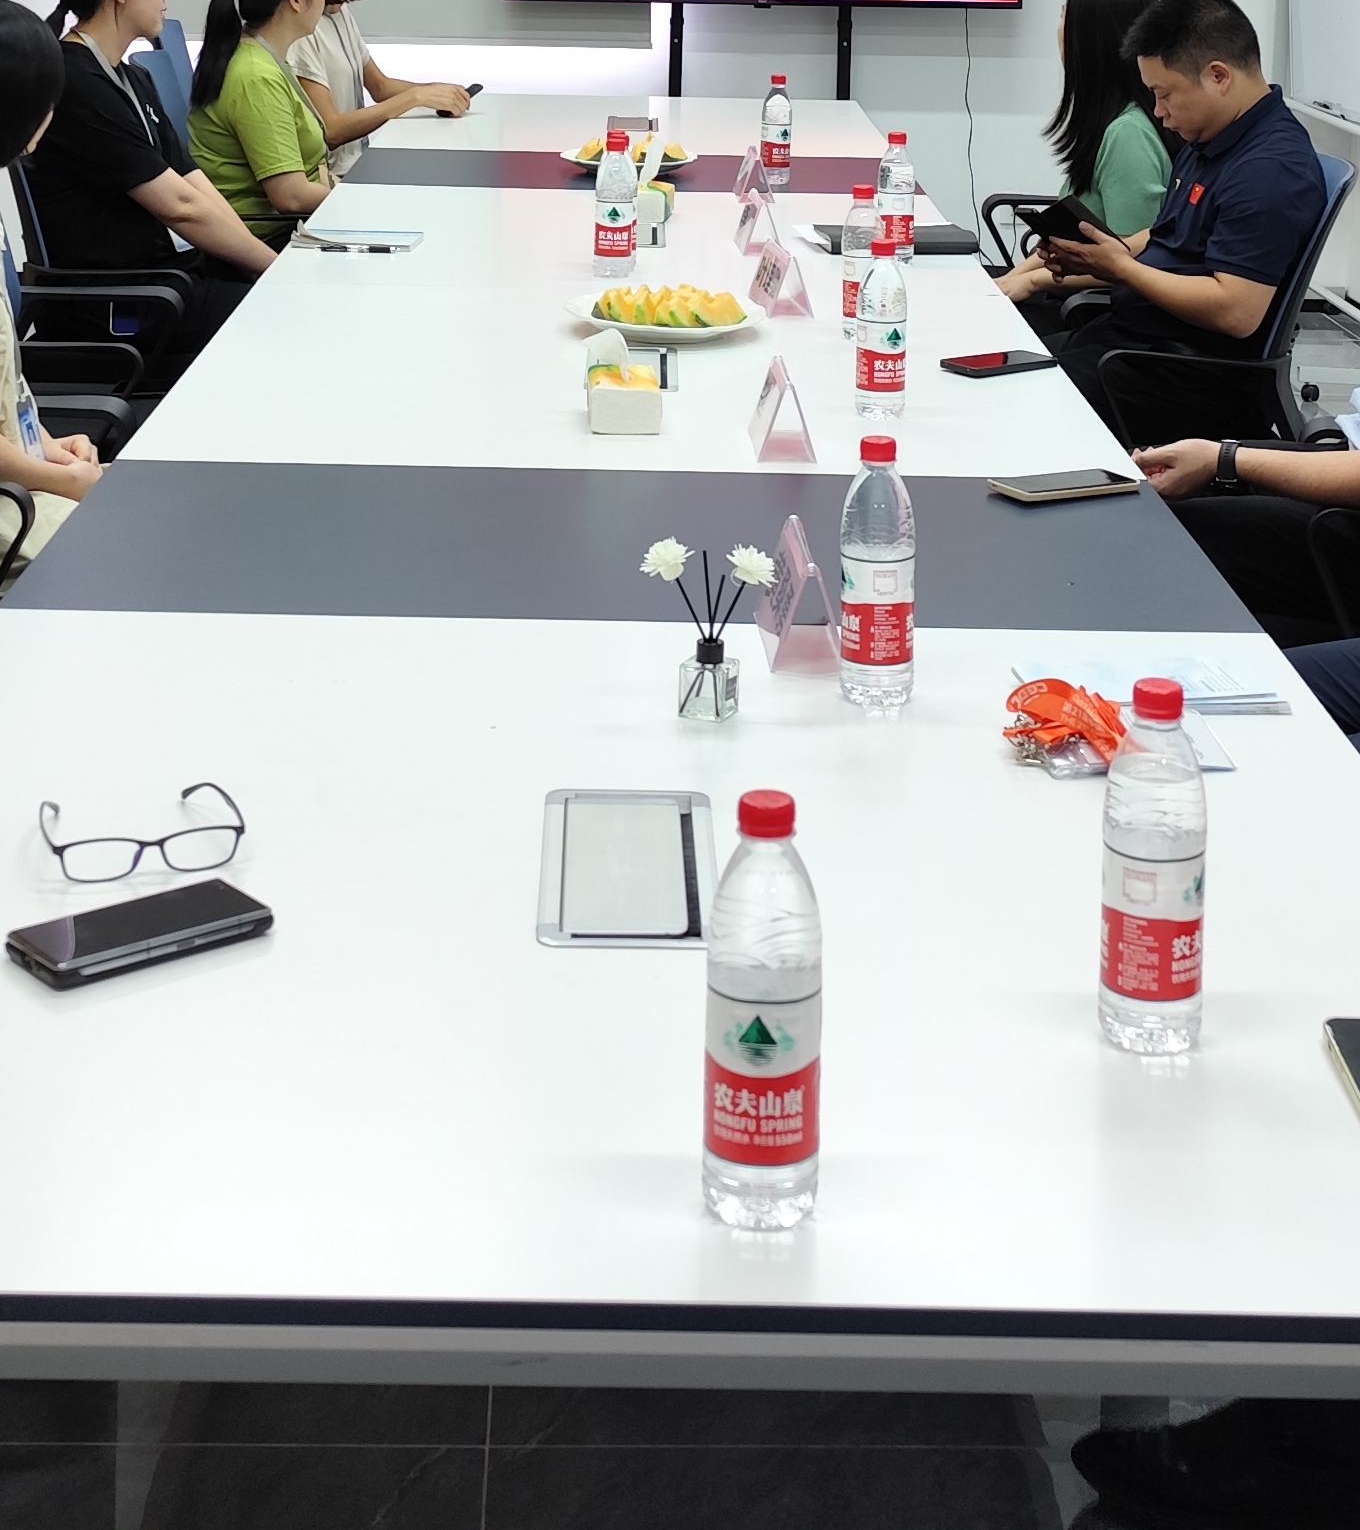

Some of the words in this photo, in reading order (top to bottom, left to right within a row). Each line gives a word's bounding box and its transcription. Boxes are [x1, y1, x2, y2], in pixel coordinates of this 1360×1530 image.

[714, 1082, 804, 1118] 农夫山泉
[713, 1108, 757, 1133] NONGFU
[760, 1115, 804, 1133] SPRING
